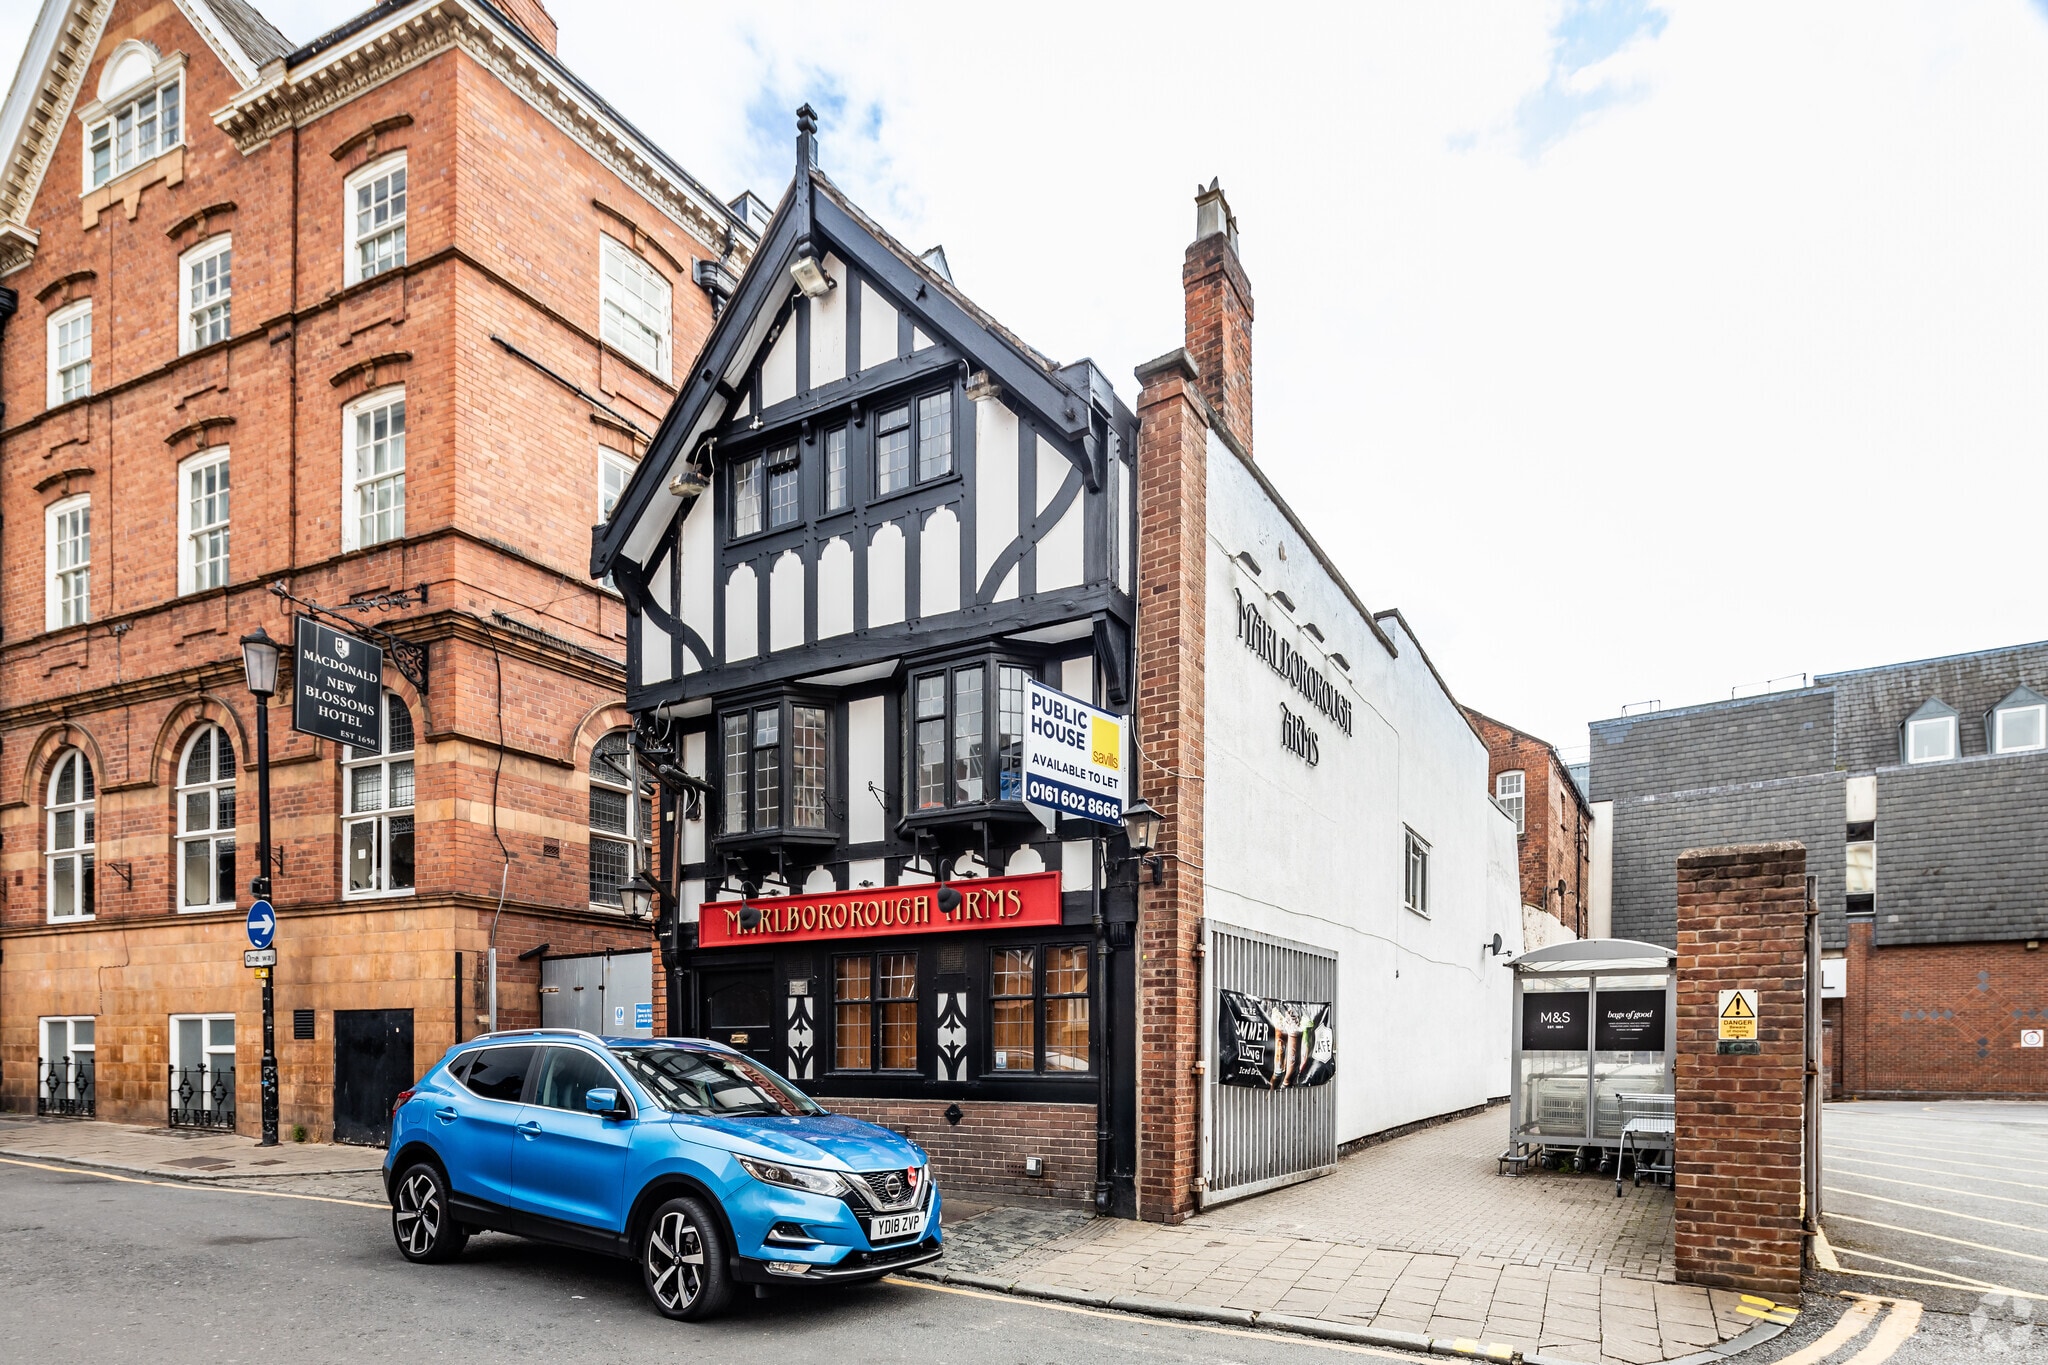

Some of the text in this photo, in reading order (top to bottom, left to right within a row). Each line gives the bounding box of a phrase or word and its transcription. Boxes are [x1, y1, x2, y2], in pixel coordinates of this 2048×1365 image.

[303, 649, 378, 683] MACDONALD
[326, 676, 357, 695] NEW
[305, 685, 375, 716] BLOSSOMS
[1031, 691, 1088, 730] PUBLIC
[318, 704, 363, 728] HOTEL
[340, 730, 376, 746] EST 1650
[1031, 714, 1086, 751] HOUSE
[1280, 701, 1319, 767] ARMS
[1032, 752, 1119, 789] AVAILABLE TO LET
[1092, 750, 1118, 769] savills
[1030, 780, 1119, 819] 0161 602 8666
[723, 895, 928, 936] MRLBOROROUGH
[246, 954, 274, 963] One way
[1540, 1011, 1571, 1024] M&S
[1625, 1010, 1635, 1020] of
[1633, 1009, 1653, 1020] good
[1242, 1045, 1260, 1060] LONG
[878, 1215, 920, 1236] YD18 ZVP
